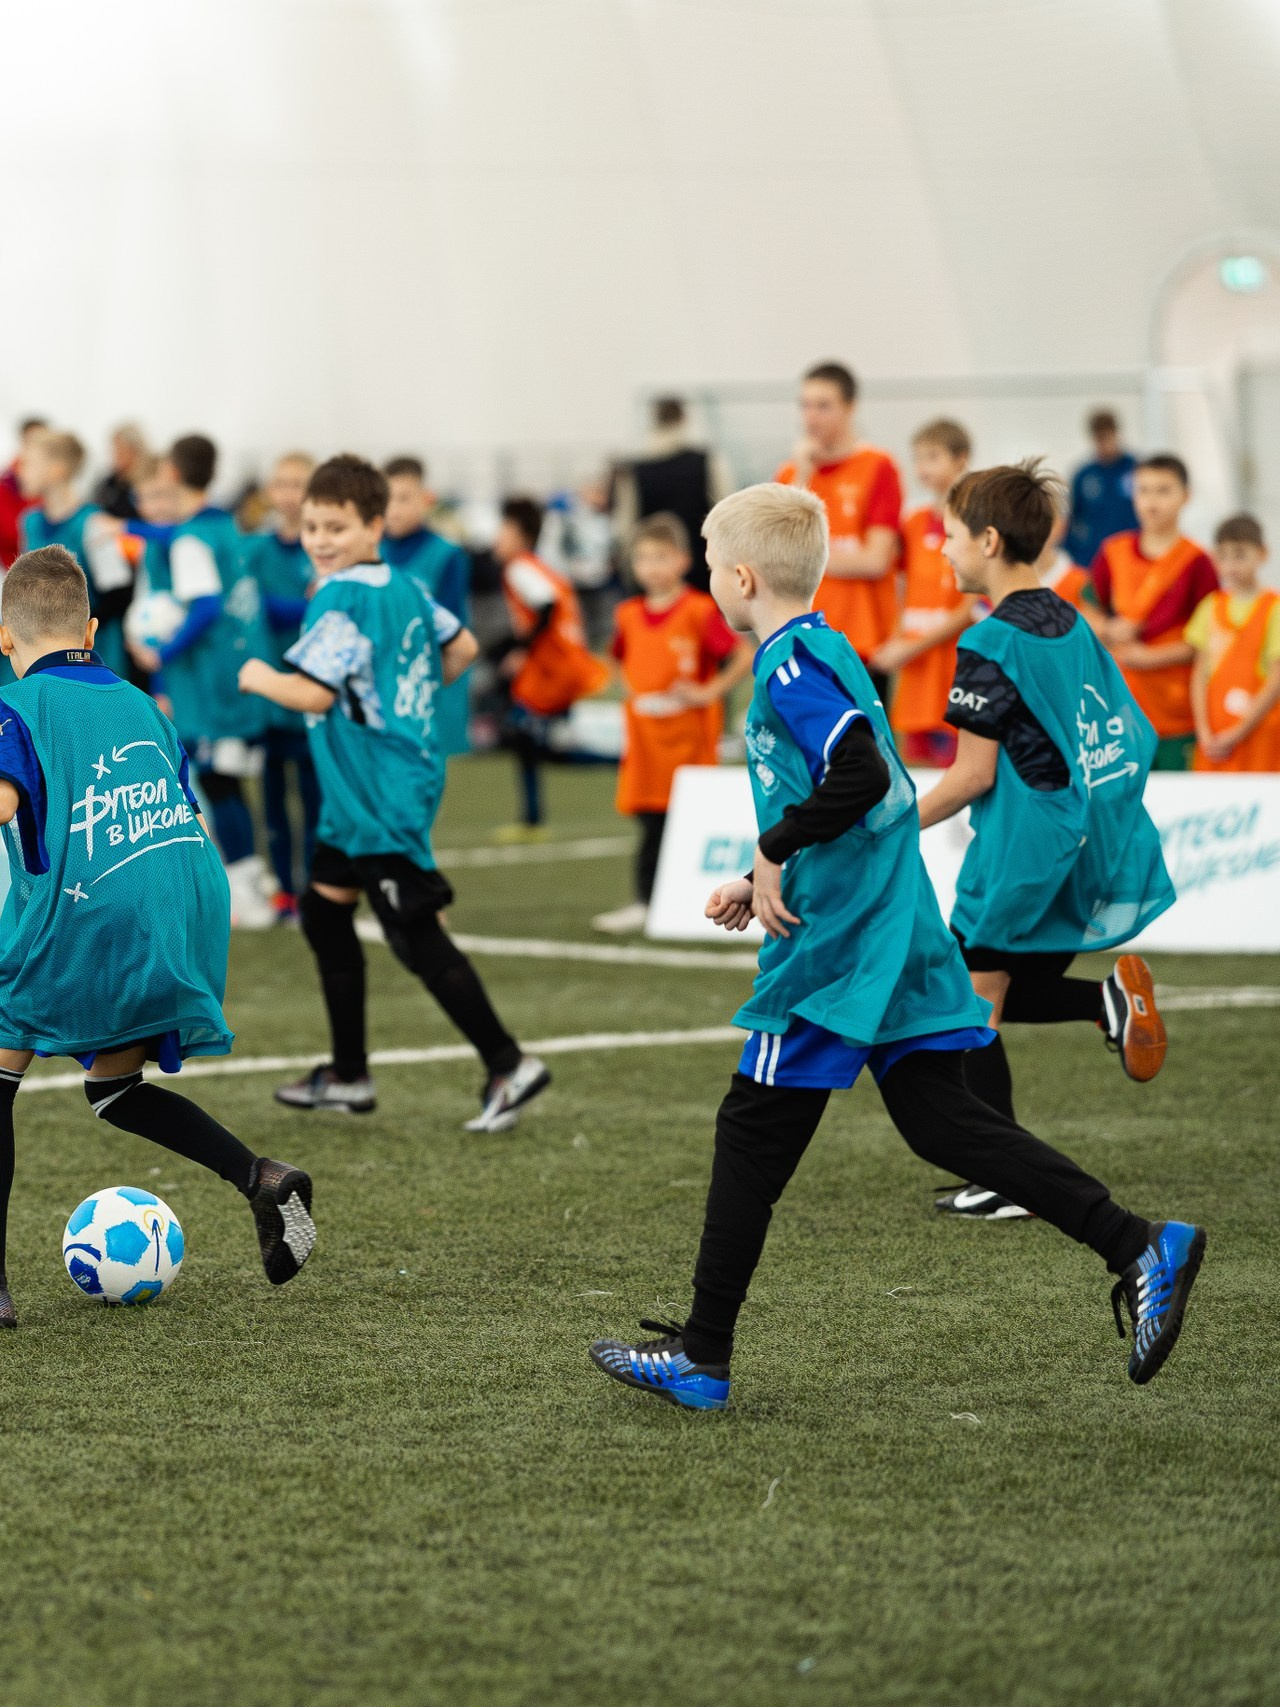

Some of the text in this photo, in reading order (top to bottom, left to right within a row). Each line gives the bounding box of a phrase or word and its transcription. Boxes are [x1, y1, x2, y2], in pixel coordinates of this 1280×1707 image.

[66, 651, 91, 660] ITALIA
[70, 778, 167, 861] ФУТБОЛ
[105, 803, 194, 846] В ШКОЛЕ
